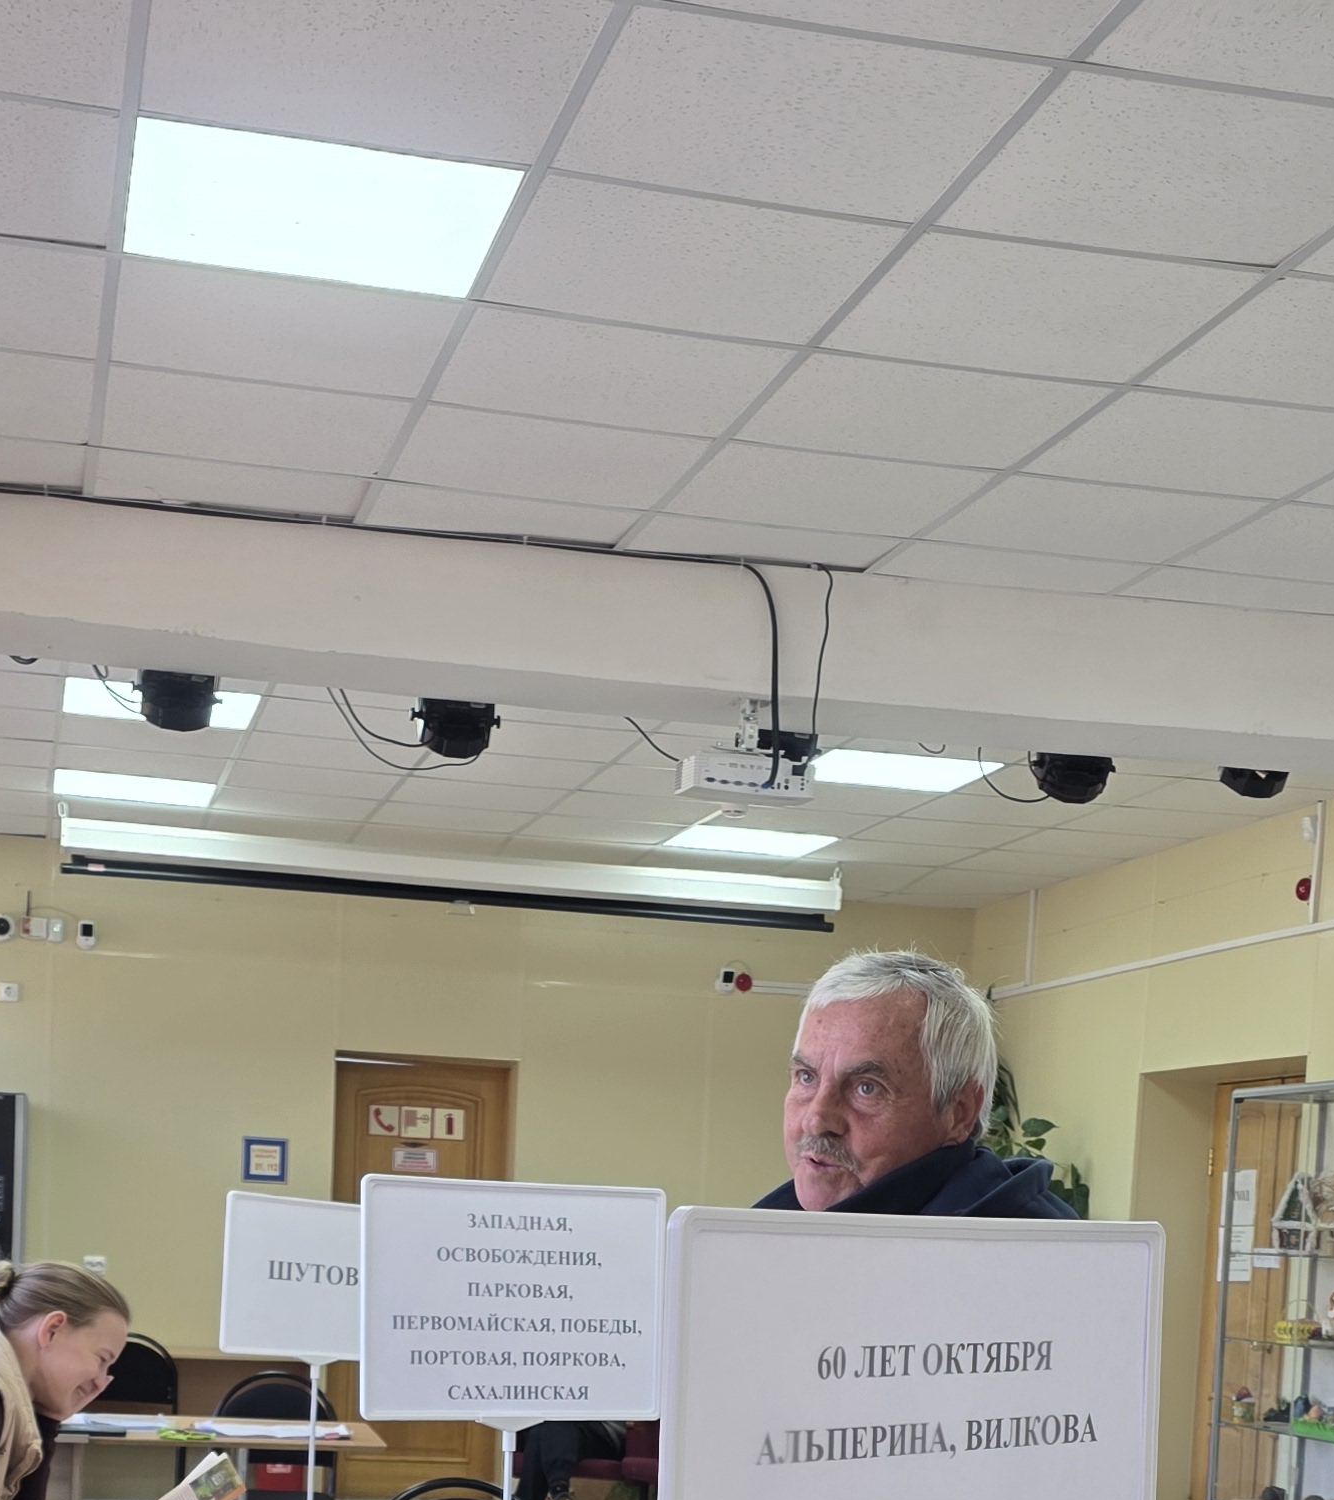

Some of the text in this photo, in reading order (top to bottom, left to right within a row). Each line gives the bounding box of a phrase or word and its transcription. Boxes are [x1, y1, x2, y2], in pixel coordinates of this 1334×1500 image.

[466, 1213, 573, 1233] ЗАПАДНАЯ,
[436, 1246, 602, 1269] ОСВОБОЖДЕНИЯ,
[267, 1259, 360, 1286] ШУТОВ
[466, 1281, 573, 1301] ПАРКОВАЯ,
[392, 1313, 642, 1337] ПЕРВОМАЙСКАЯ, ПОБЕДЫ,
[409, 1349, 626, 1370] ПОРТОВАЯ, ПОЯРКОВА,
[817, 1340, 1054, 1380] 60 ЛЕТ ОКТЯБРЯ
[447, 1383, 589, 1401] САХАЛИНСКАЯ
[755, 1412, 1098, 1466] АЛЬПЕРИНА, ВИЛКОВА
